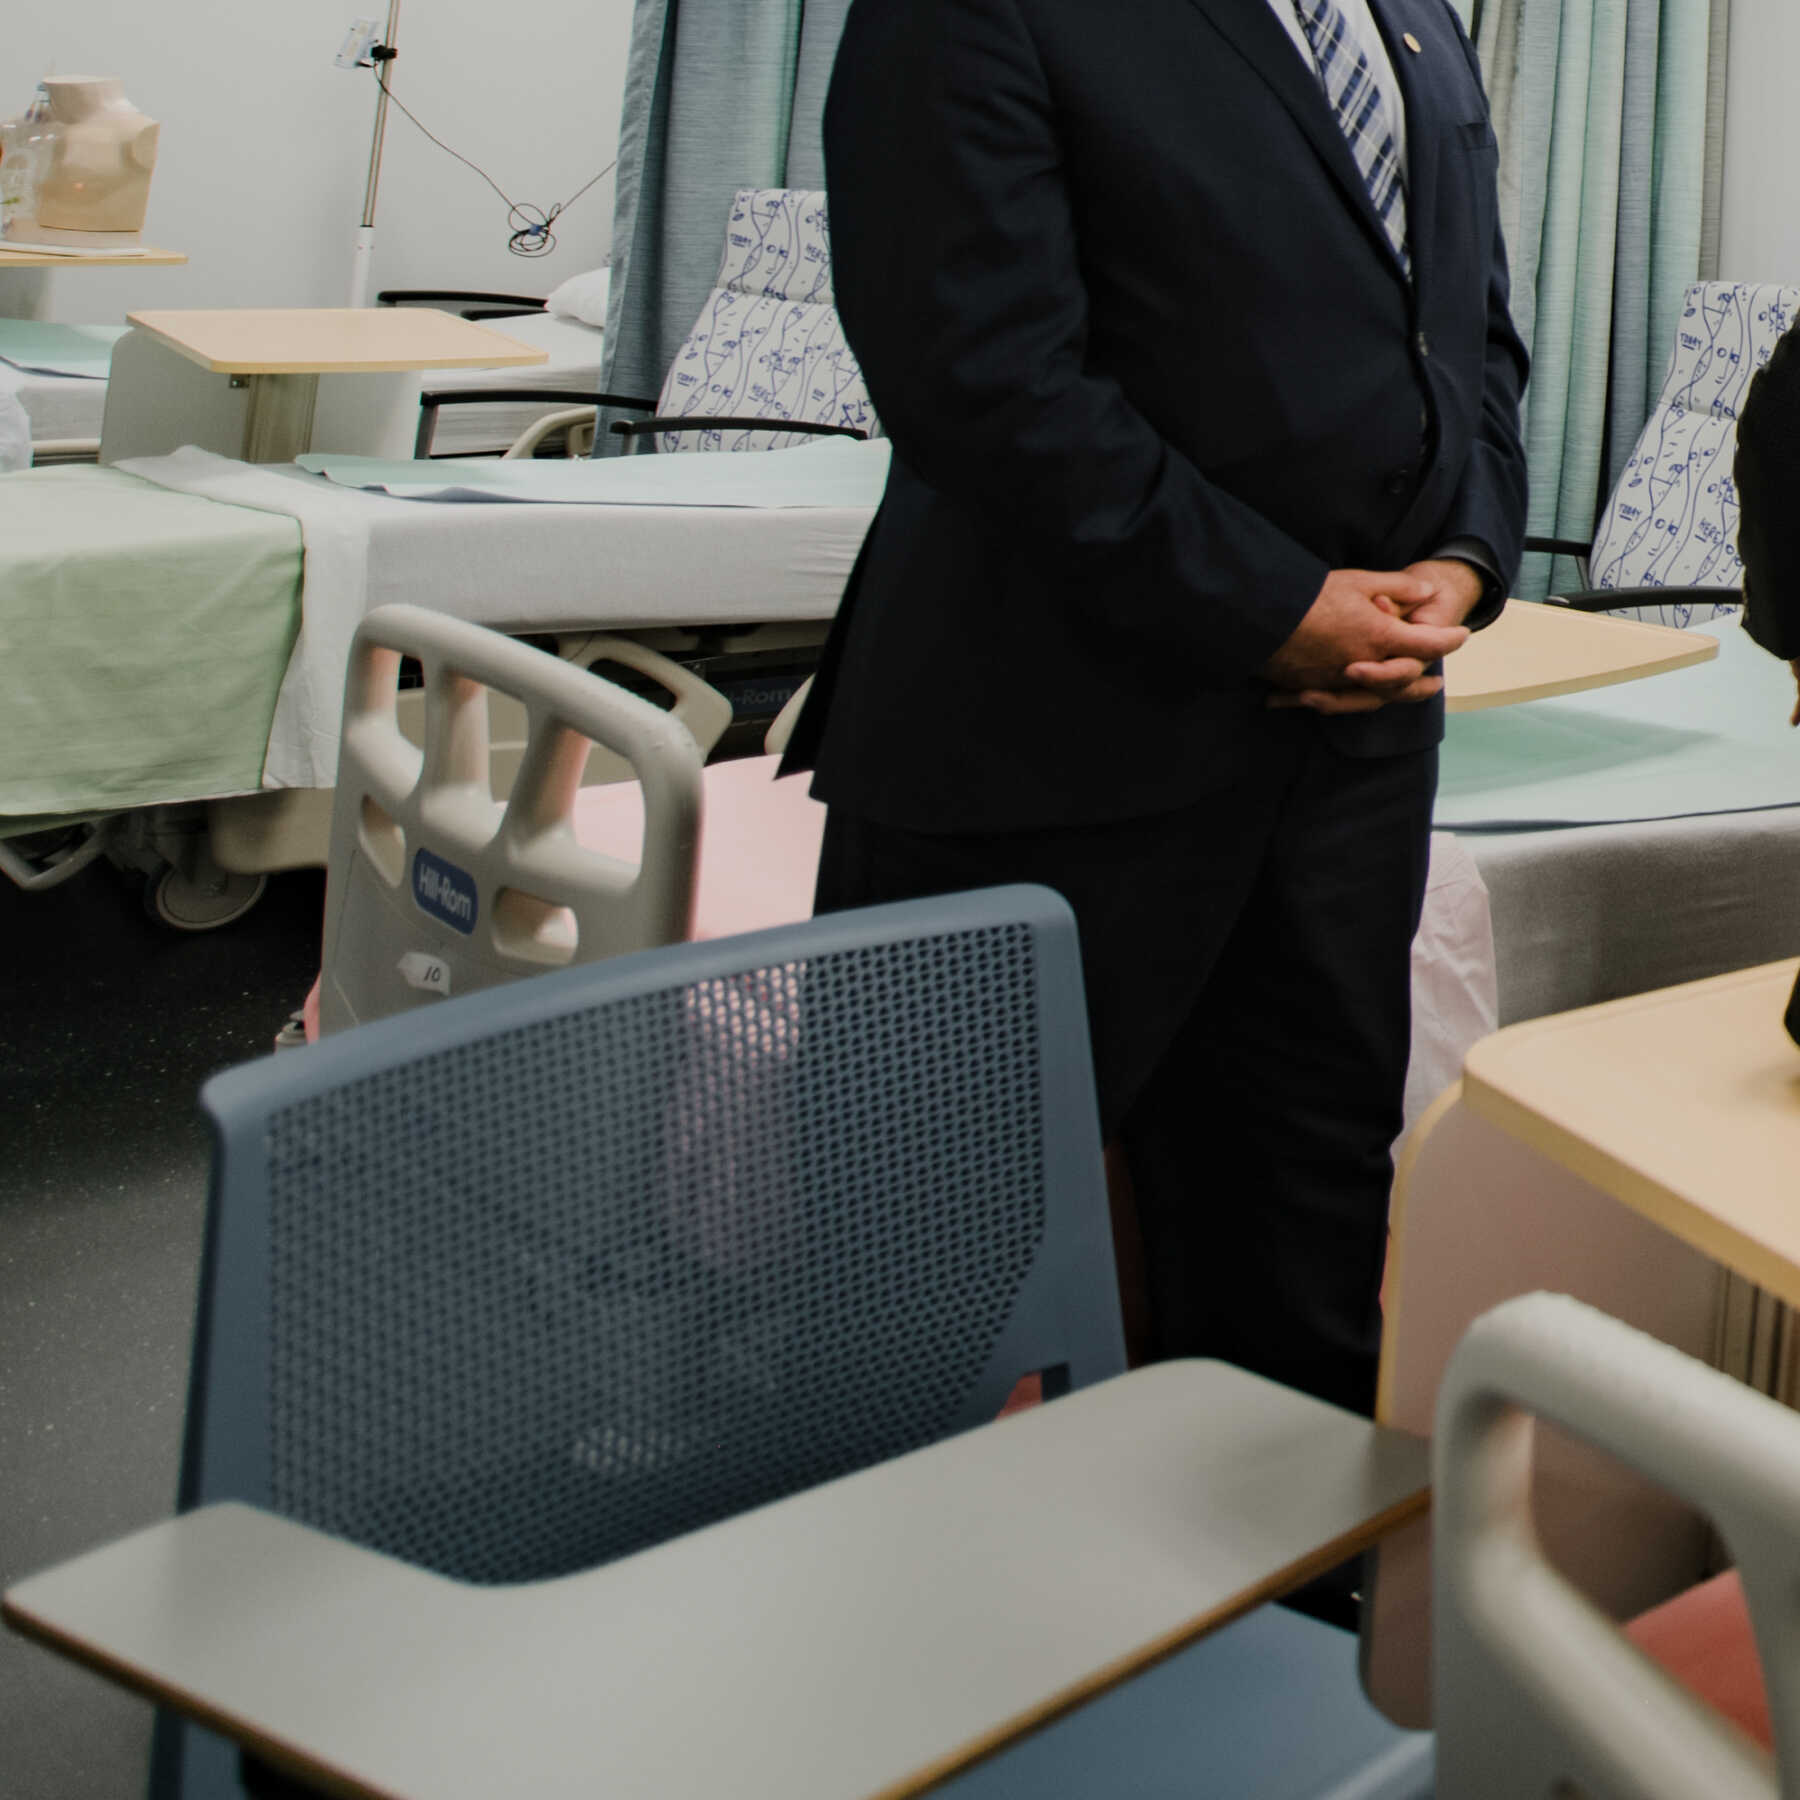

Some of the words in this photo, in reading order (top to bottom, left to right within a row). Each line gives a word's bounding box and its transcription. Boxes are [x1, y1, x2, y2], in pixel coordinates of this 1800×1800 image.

[1680, 332, 1703, 351] TODAY
[1618, 503, 1643, 521] TODAY
[1699, 516, 1721, 544] HERE
[420, 863, 472, 920] Hill-Rom
[423, 965, 441, 983] 10
